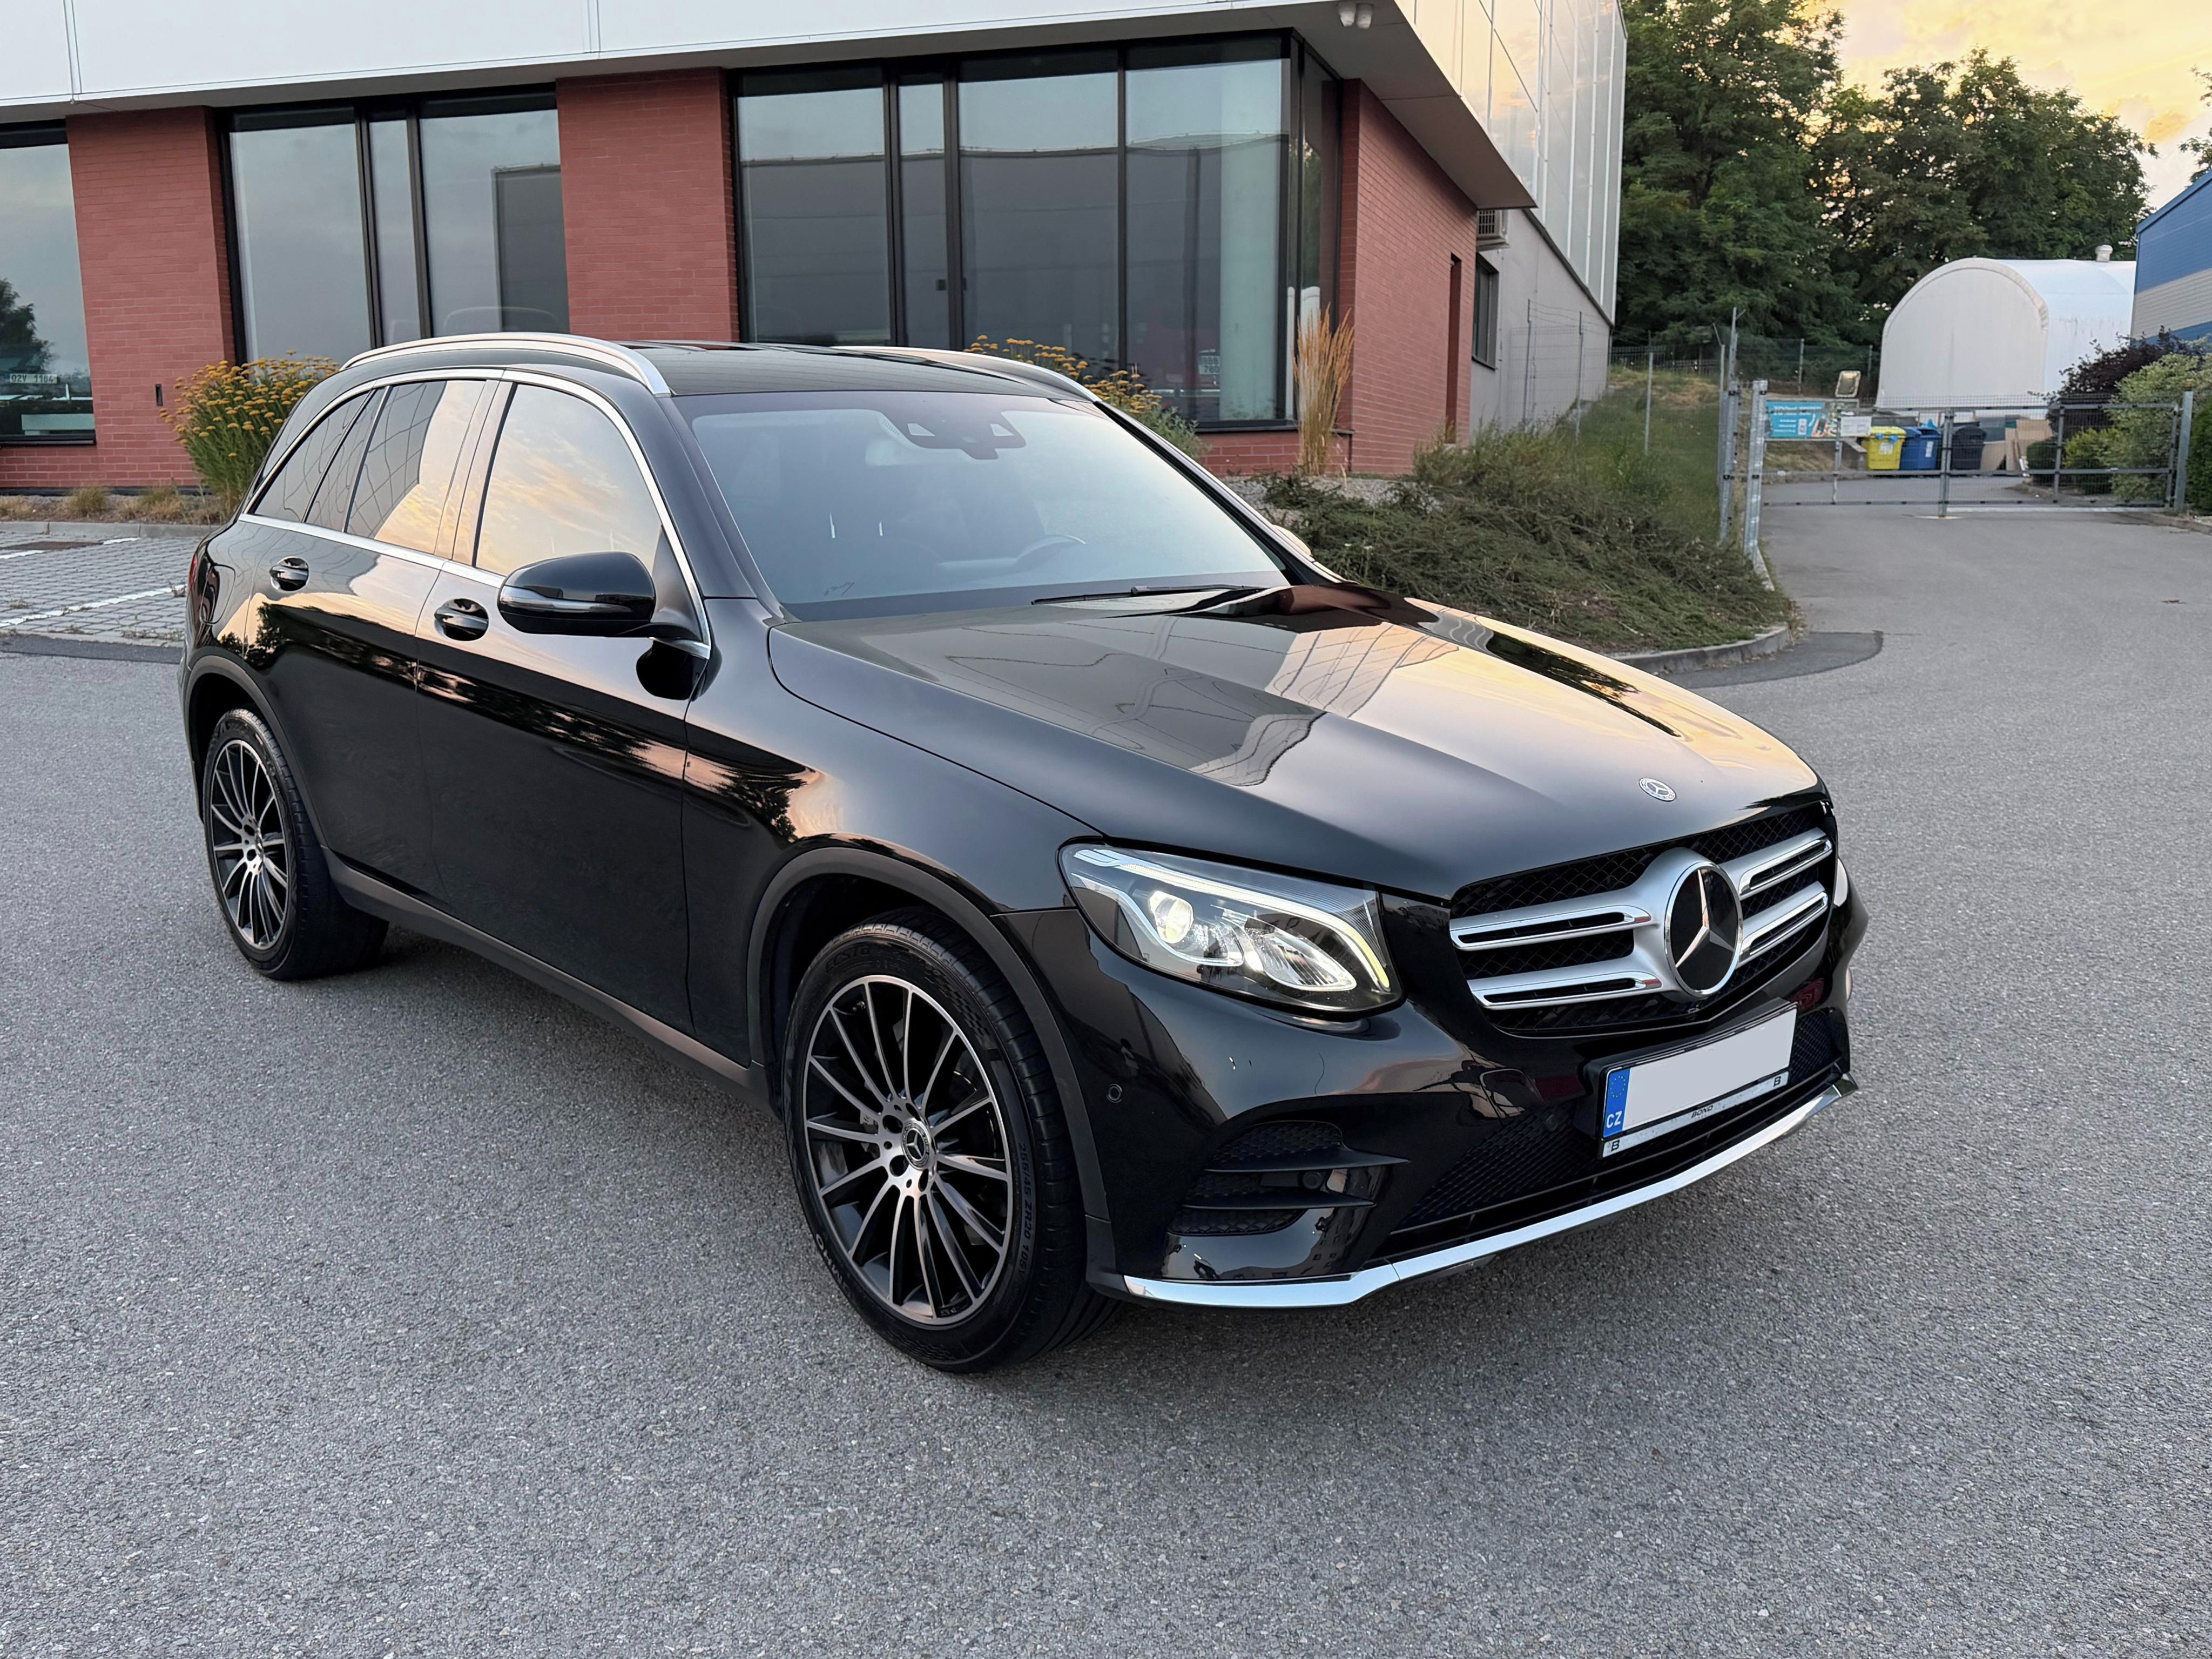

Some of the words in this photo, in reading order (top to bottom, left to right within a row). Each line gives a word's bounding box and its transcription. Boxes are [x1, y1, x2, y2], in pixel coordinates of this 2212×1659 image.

[1606, 1110, 1622, 1128] CZ
[1611, 1139, 1620, 1152] B
[1773, 1075, 1782, 1087] B
[1019, 1142, 1032, 1196] 255/45
[1024, 1199, 1033, 1239] ZR20
